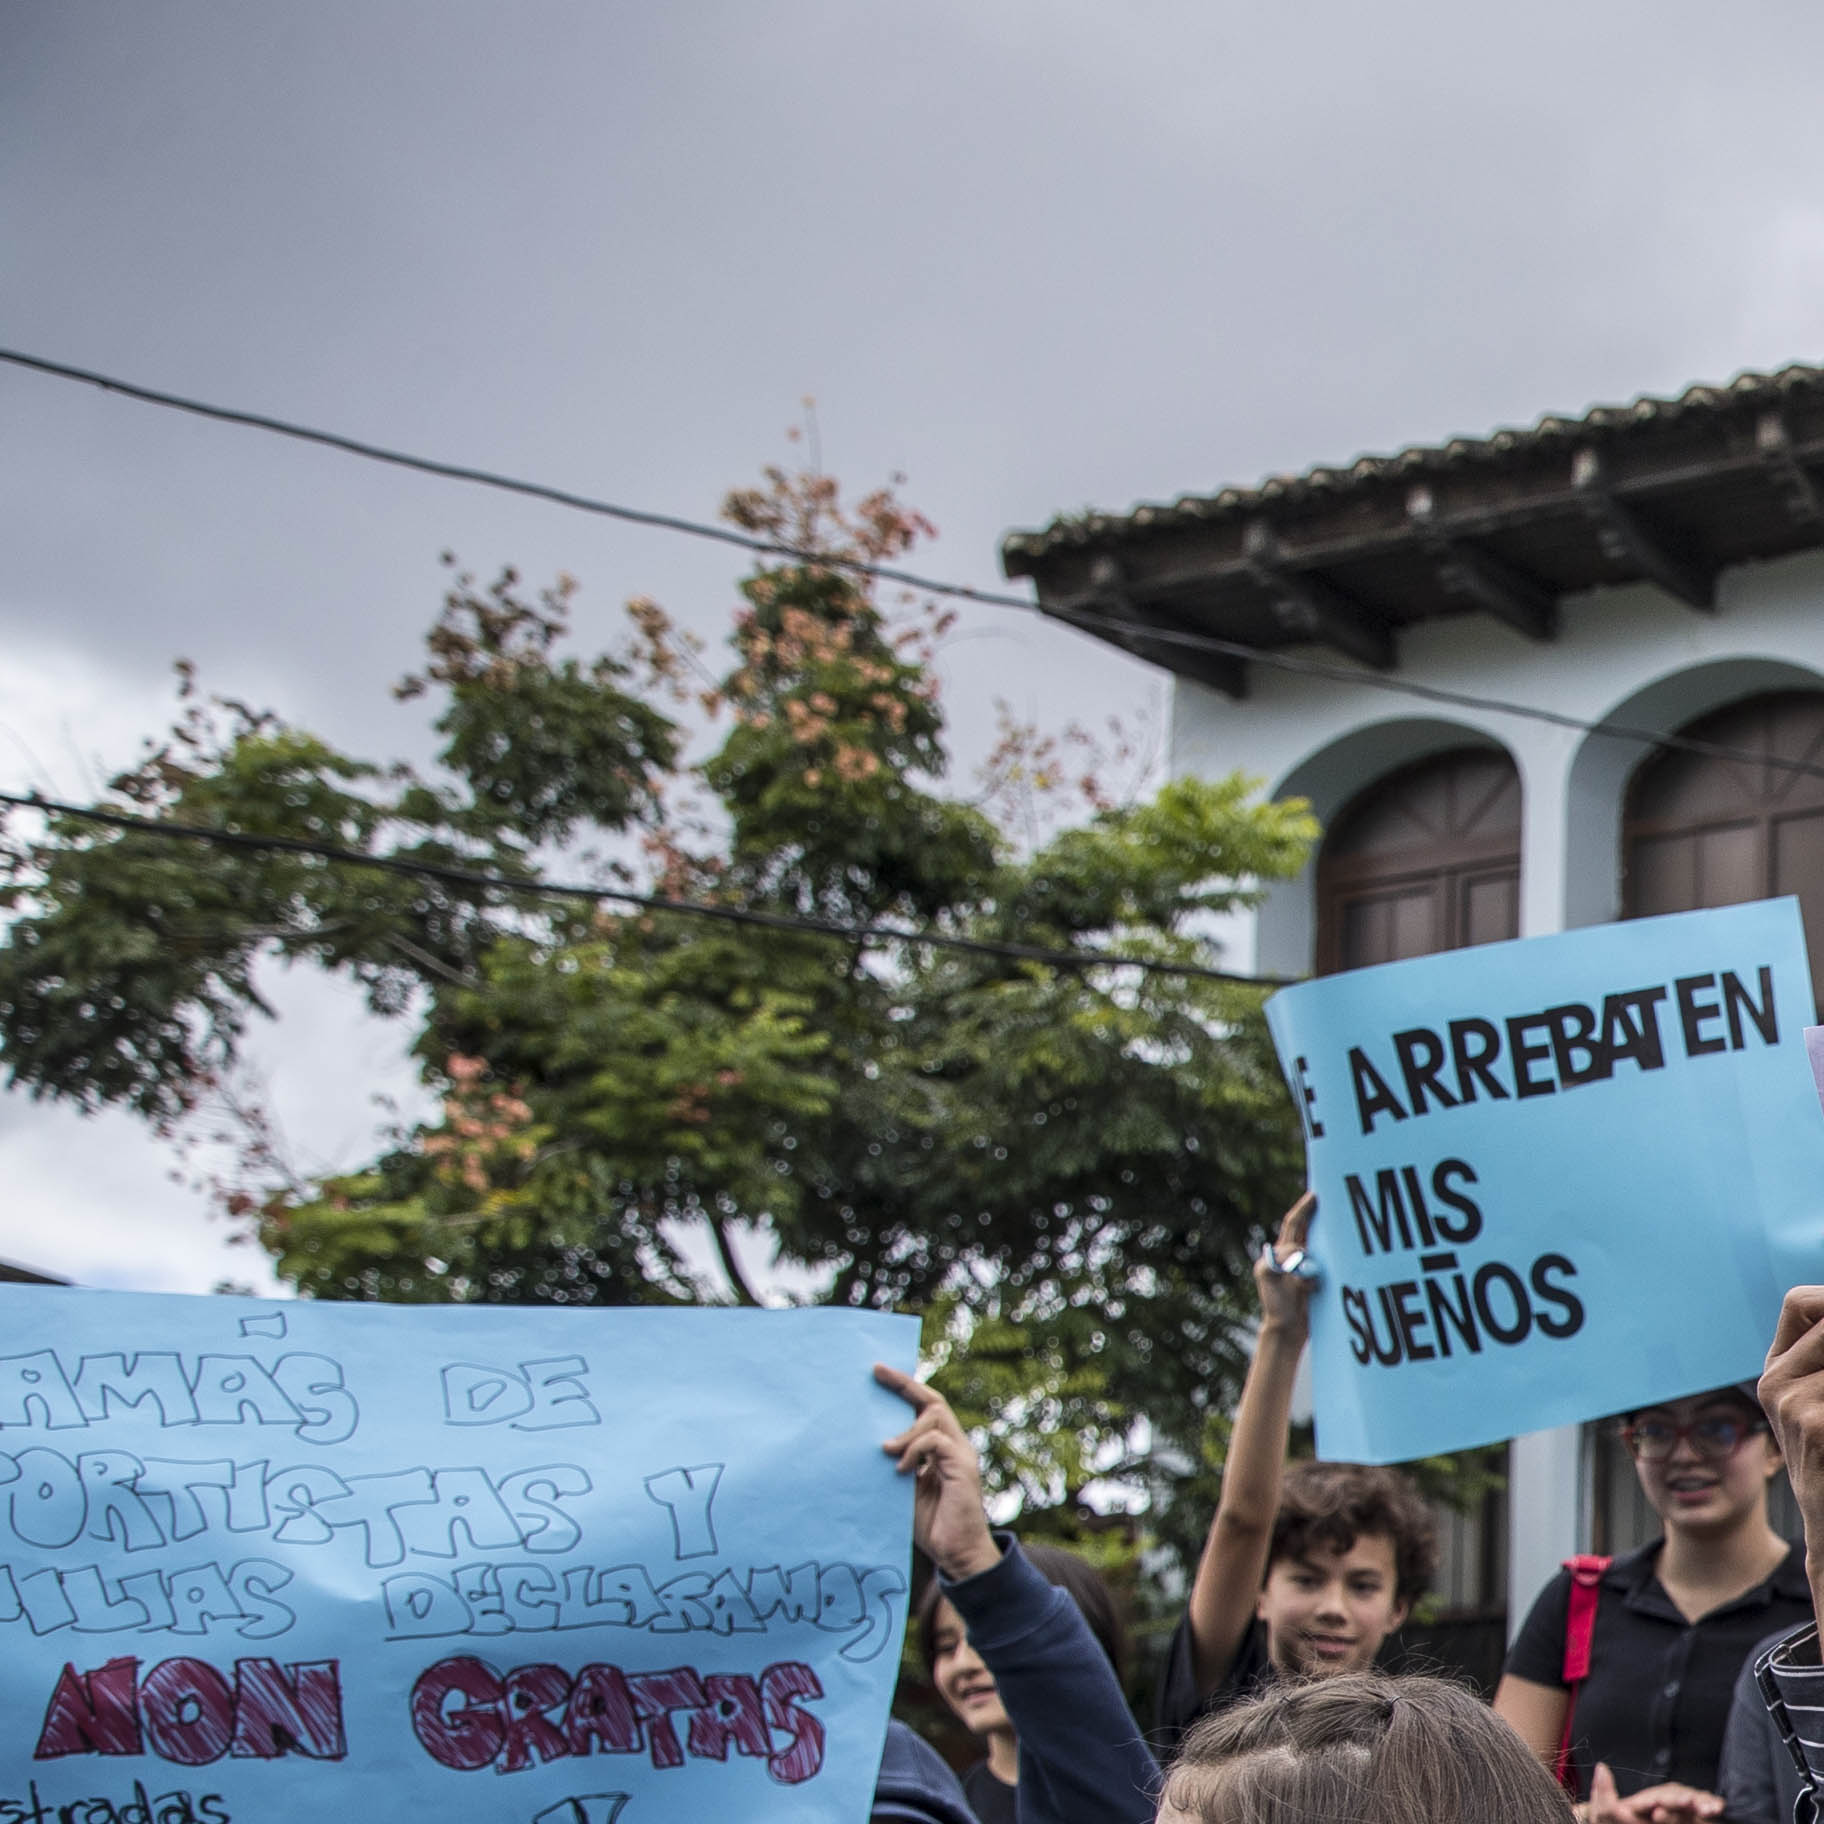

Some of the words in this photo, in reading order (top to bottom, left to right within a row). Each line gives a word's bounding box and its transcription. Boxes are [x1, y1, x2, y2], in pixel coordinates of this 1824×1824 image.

[1348, 964, 1780, 1137] ARREBATEN
[1345, 1156, 1483, 1258] MIS
[1341, 1252, 1586, 1368] SUEÑOS
[441, 1355, 602, 1431] DE
[645, 1463, 726, 1560] Y
[34, 1656, 348, 1765] NON
[411, 1656, 826, 1785] GRATAS
